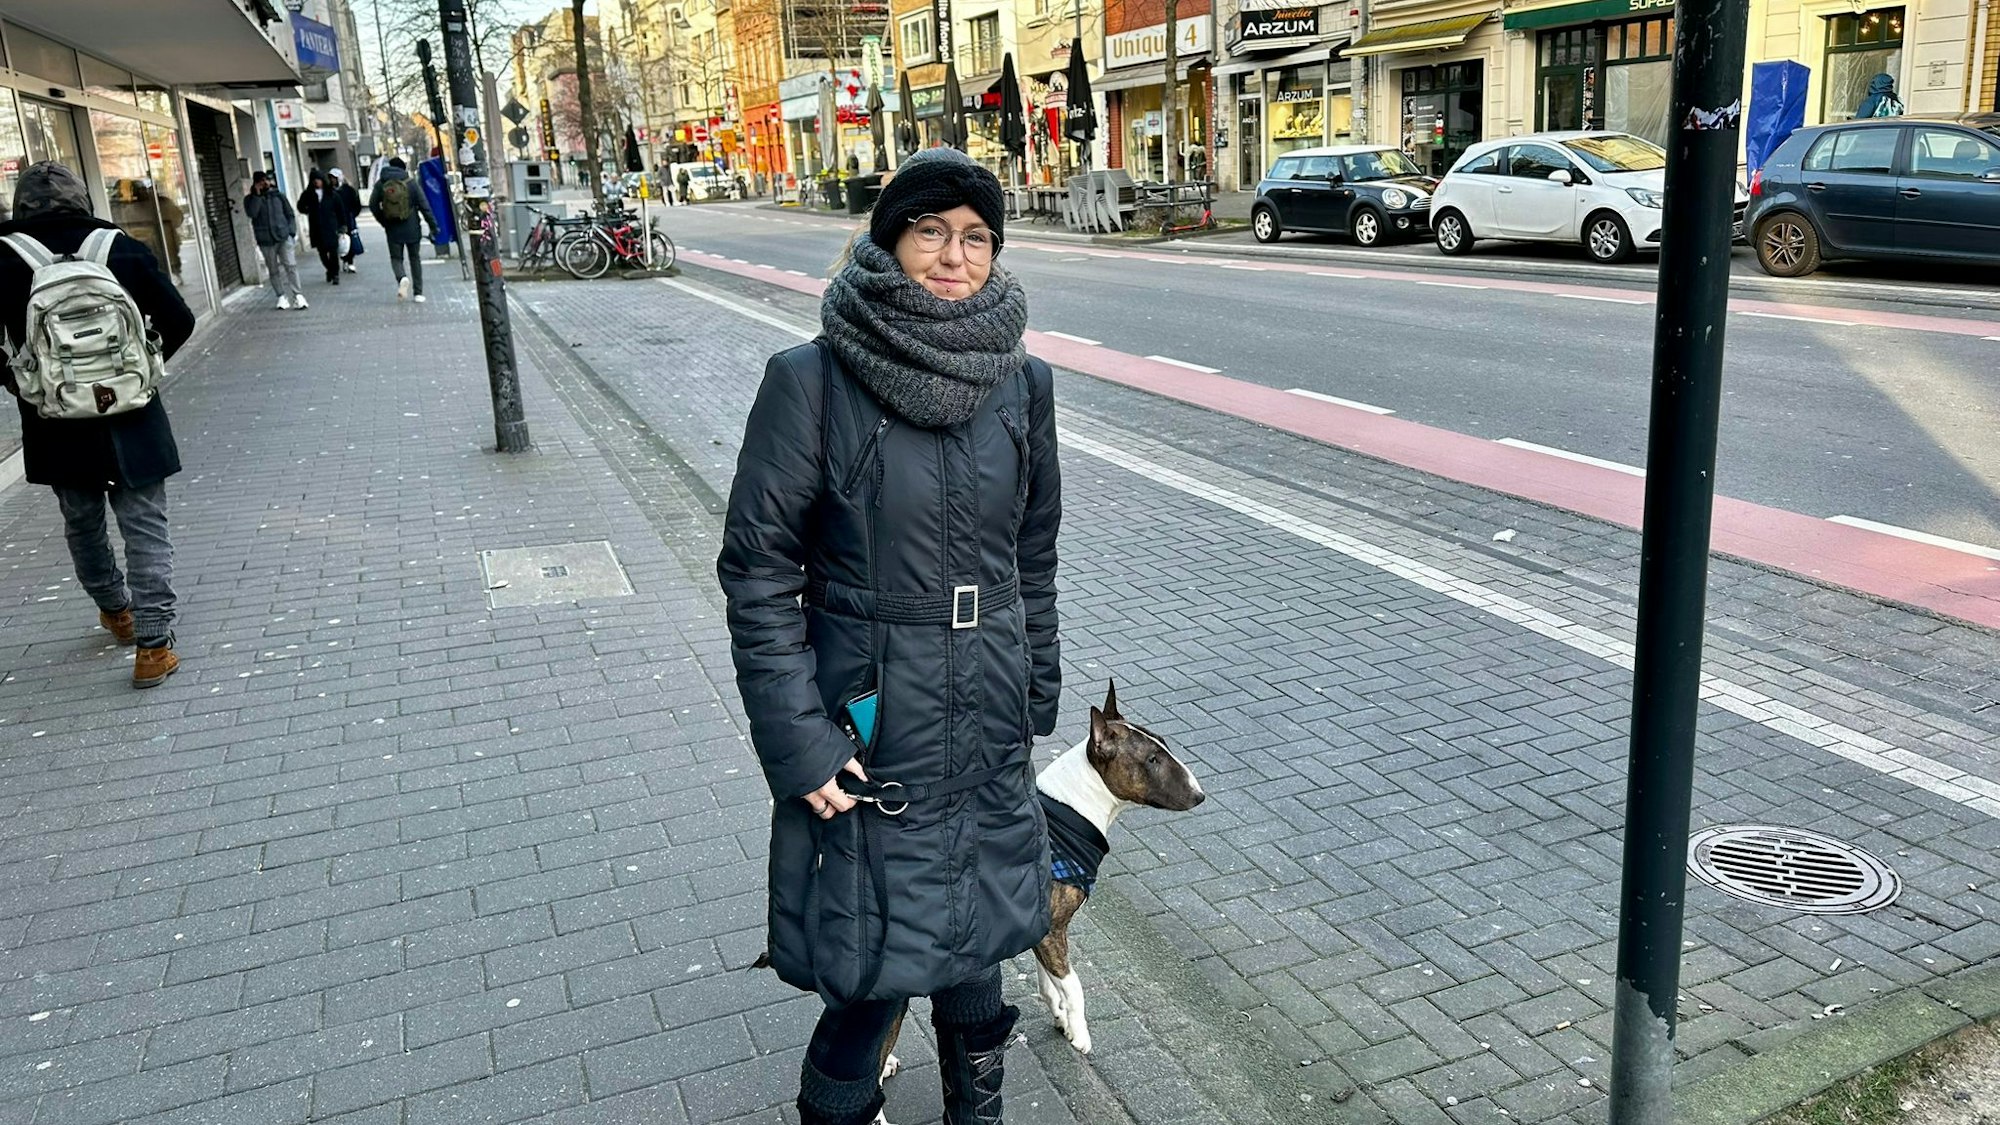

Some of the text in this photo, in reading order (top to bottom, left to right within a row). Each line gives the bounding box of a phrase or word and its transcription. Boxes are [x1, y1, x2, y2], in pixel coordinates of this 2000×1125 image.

[1243, 19, 1315, 36] ARZUM
[300, 28, 333, 57] PANTERA
[1113, 23, 1197, 58] Uniqu 4
[1277, 89, 1313, 102] ARZUM
